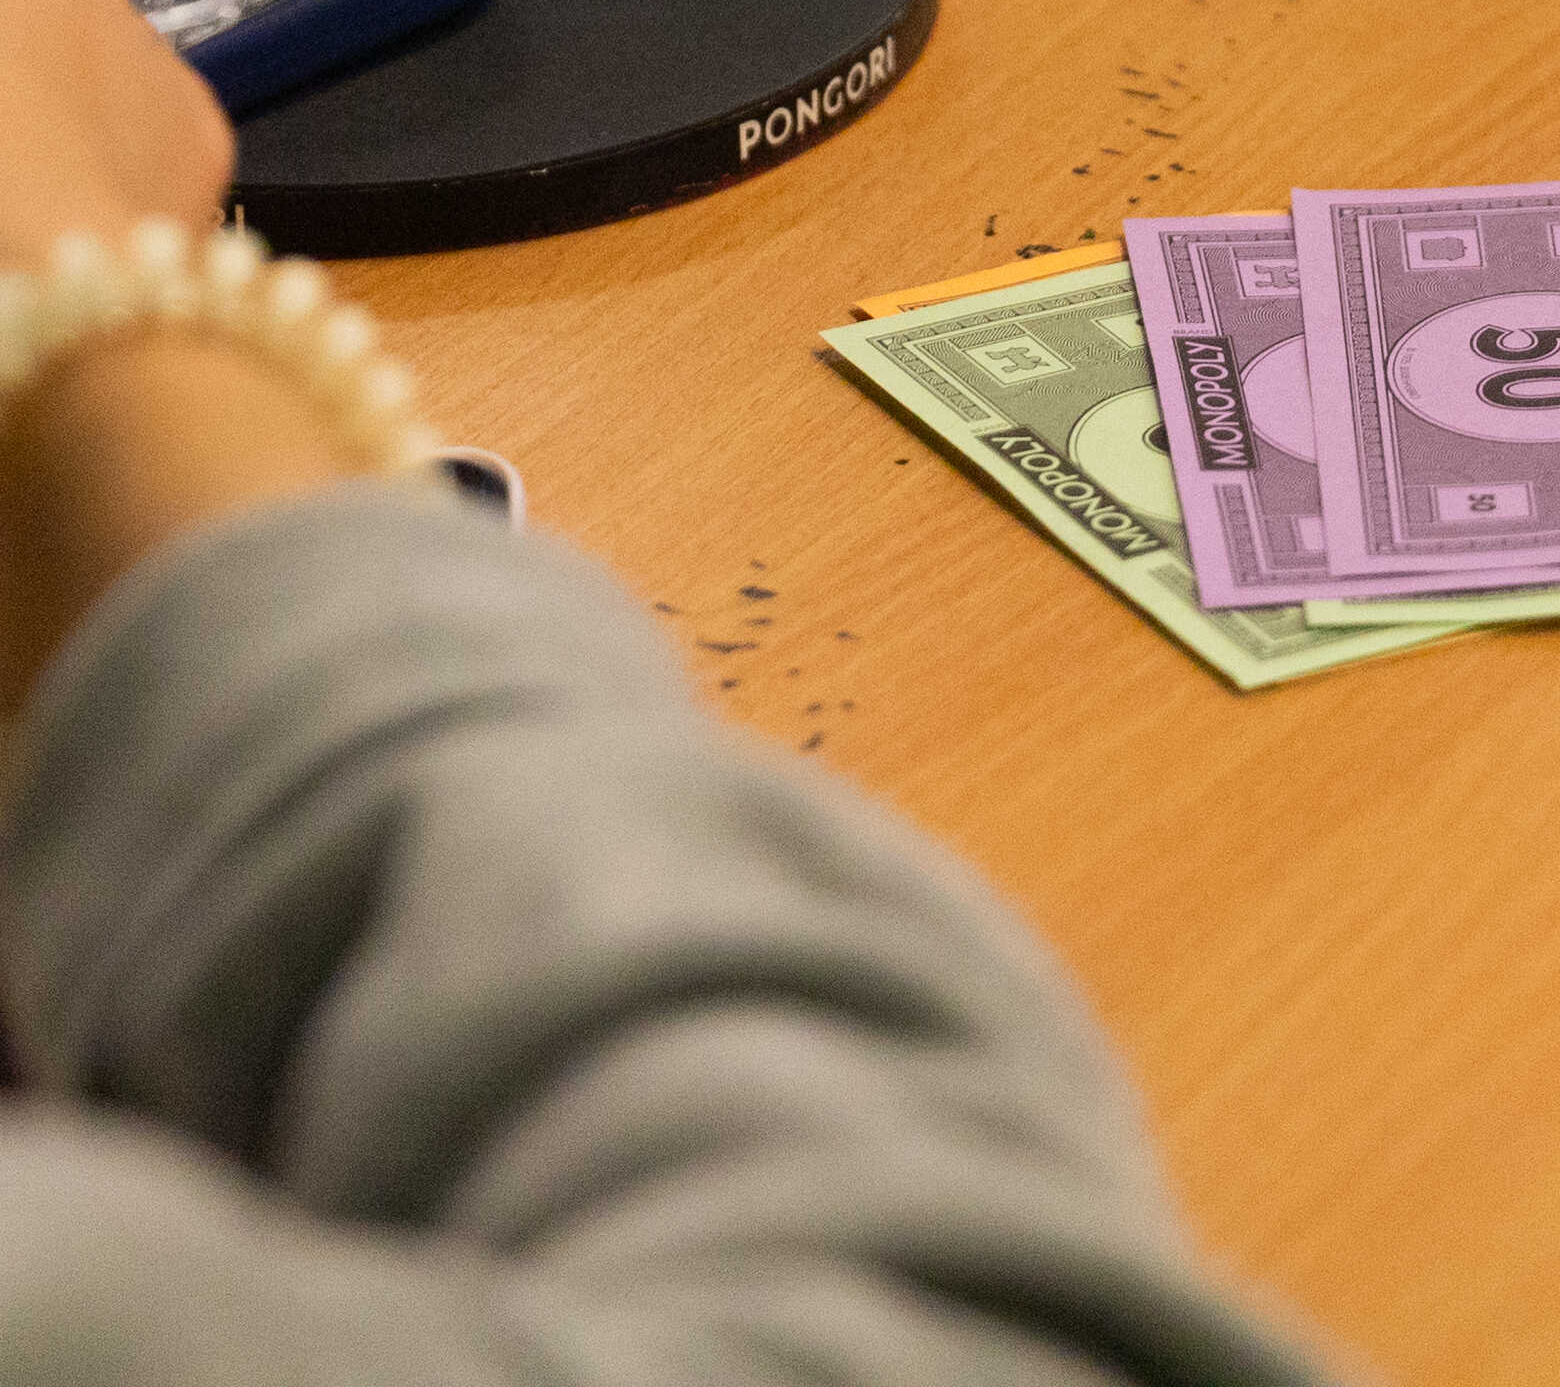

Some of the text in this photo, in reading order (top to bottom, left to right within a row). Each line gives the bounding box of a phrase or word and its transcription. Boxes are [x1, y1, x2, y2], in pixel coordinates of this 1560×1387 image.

[738, 35, 897, 161] PONGORI
[1184, 340, 1249, 467] MONOPOLY
[991, 435, 1161, 553] MONOPOLY
